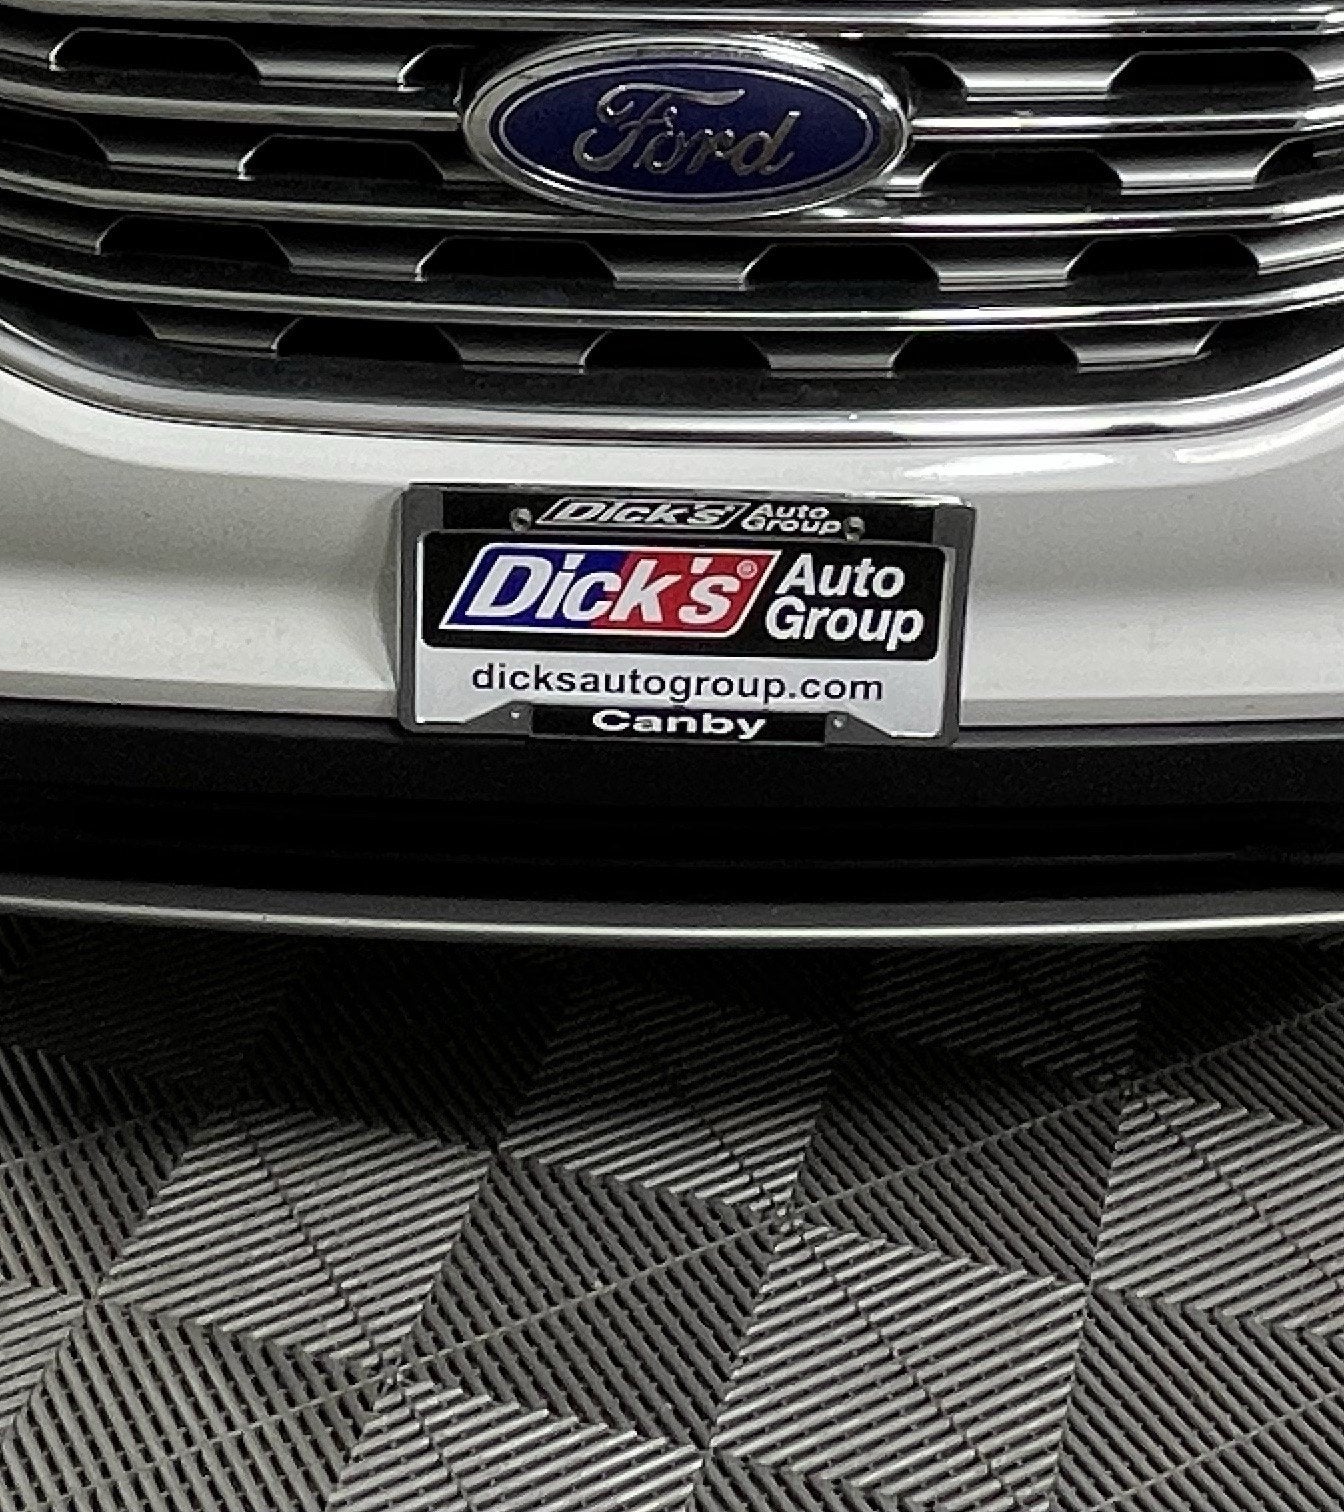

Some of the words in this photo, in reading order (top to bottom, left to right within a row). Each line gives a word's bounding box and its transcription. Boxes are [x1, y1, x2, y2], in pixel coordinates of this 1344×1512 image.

[572, 83, 803, 174] Ford
[553, 499, 730, 525] Dick's
[742, 517, 842, 535] Group
[753, 502, 829, 519] Auto
[464, 554, 741, 624] Dick's
[776, 554, 905, 598] Auto
[765, 597, 925, 651] Group
[472, 664, 884, 702] dicksautogroup.com
[591, 709, 769, 740] Canby
